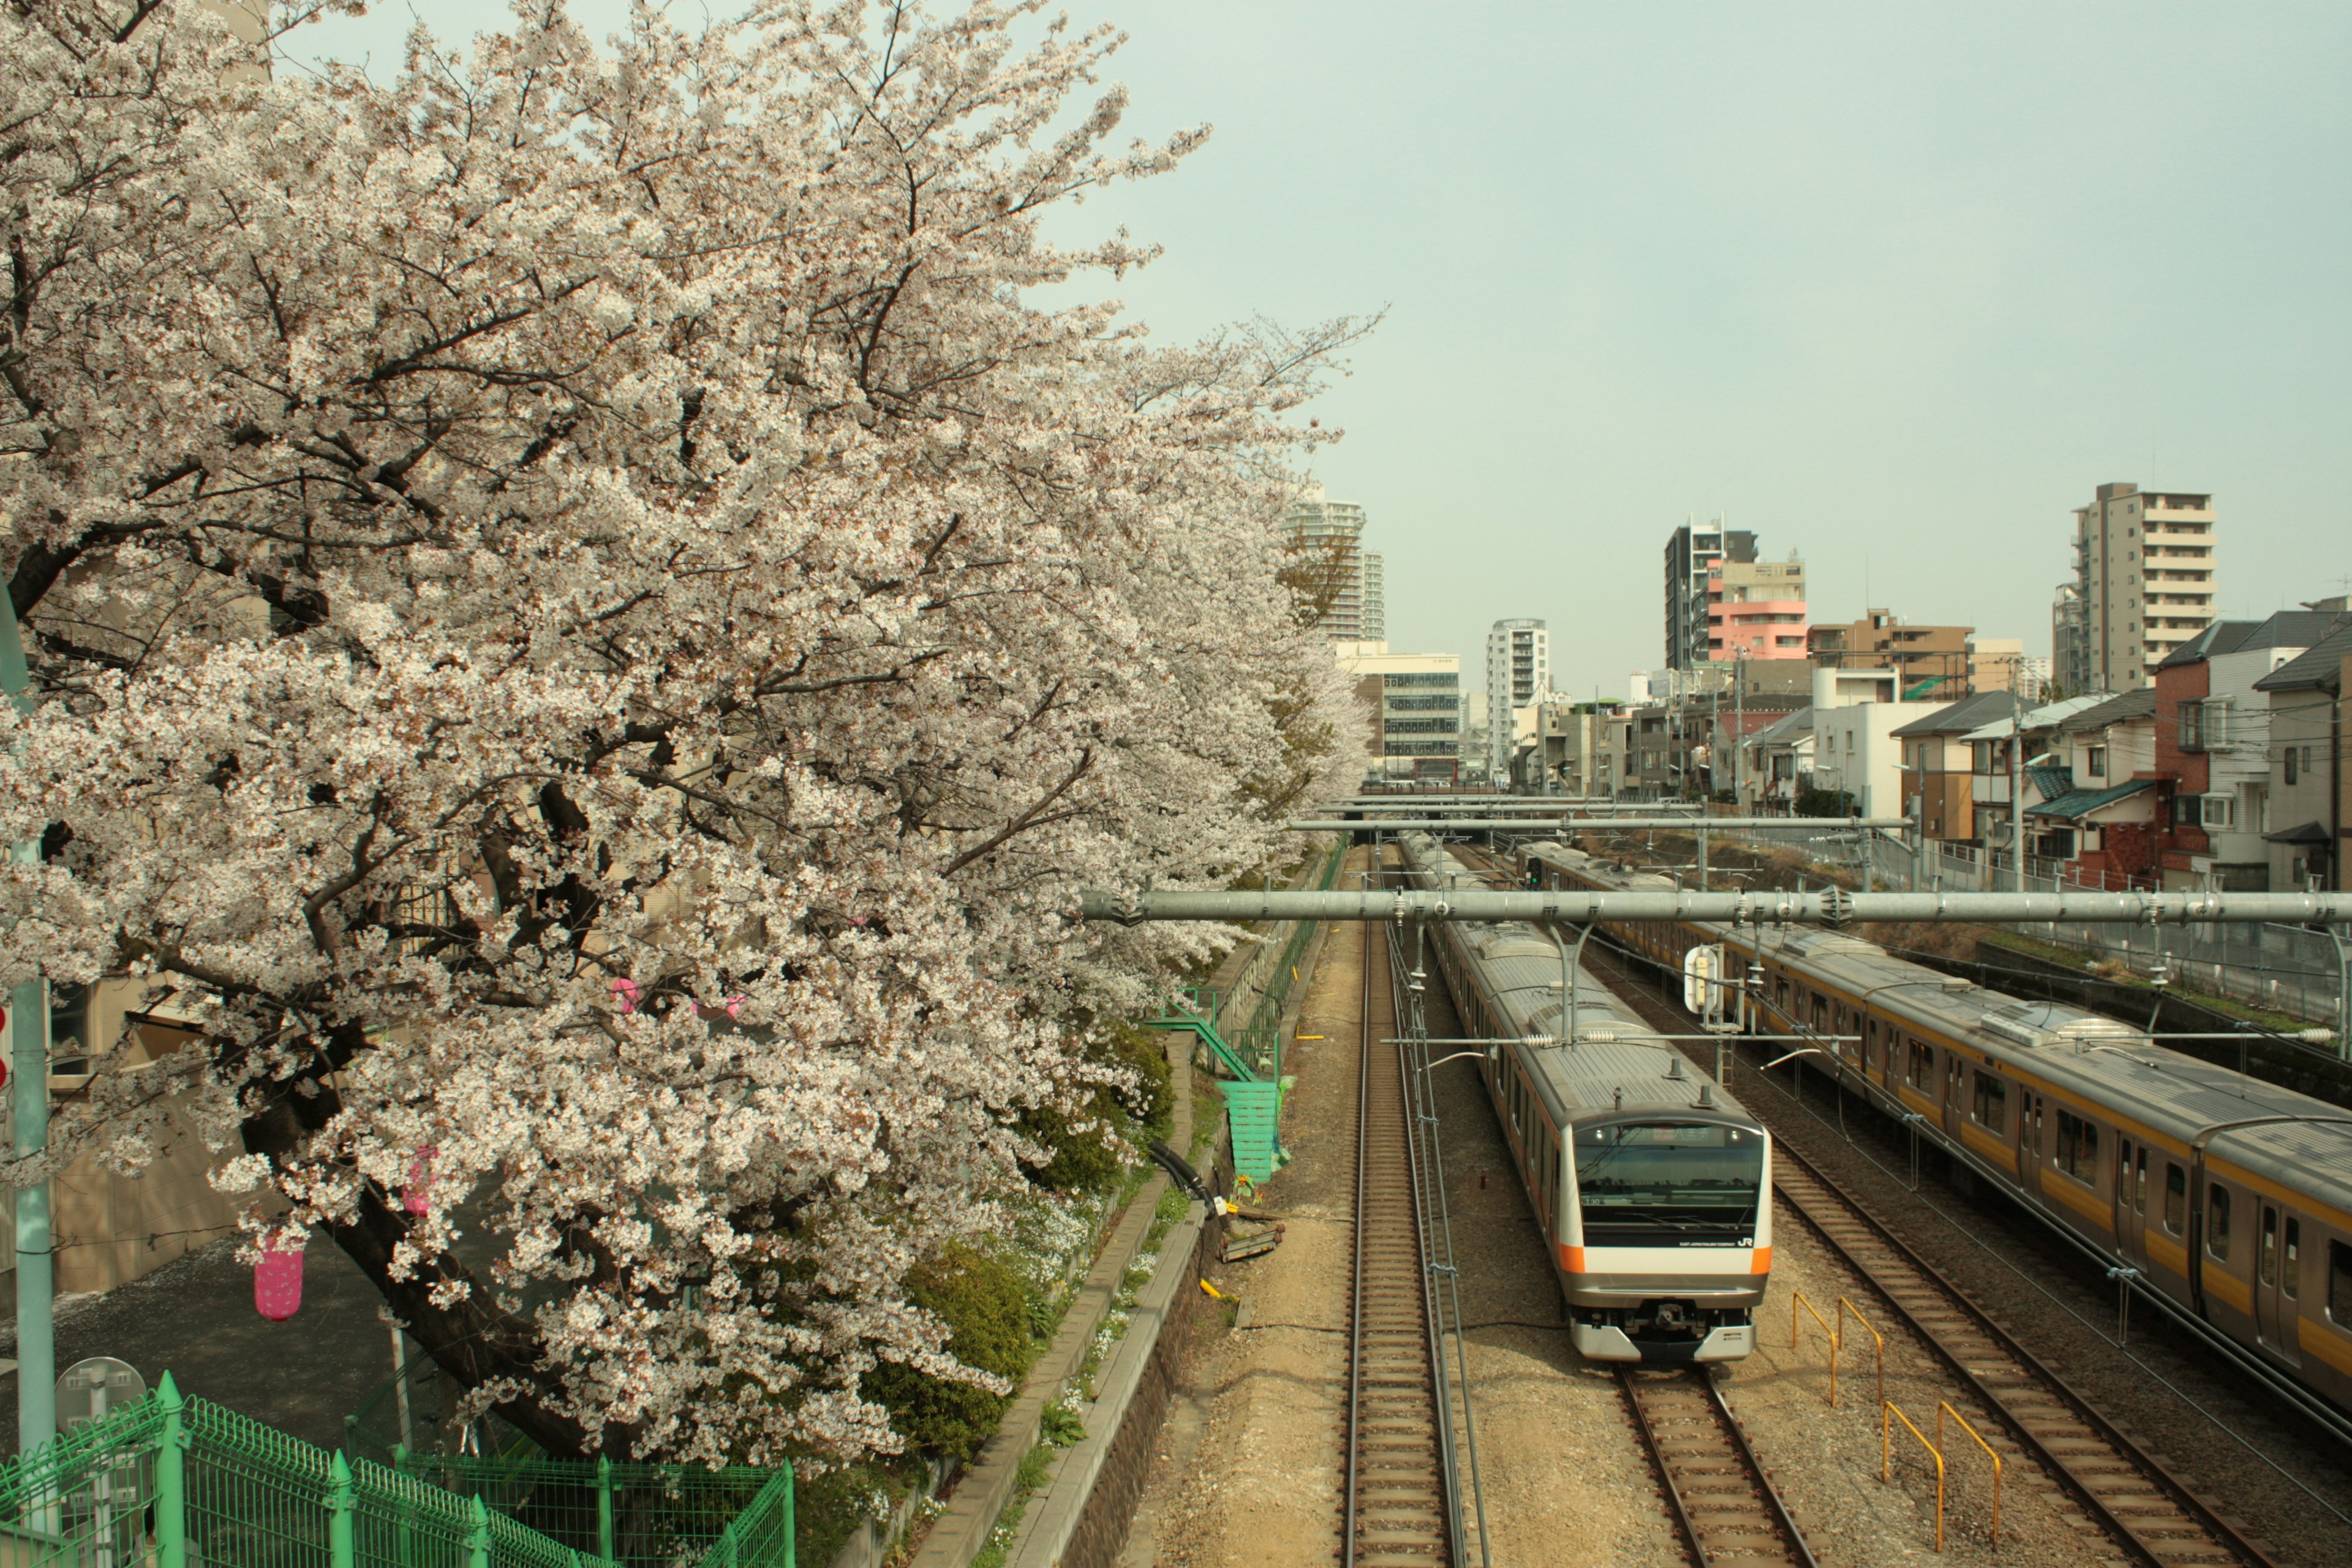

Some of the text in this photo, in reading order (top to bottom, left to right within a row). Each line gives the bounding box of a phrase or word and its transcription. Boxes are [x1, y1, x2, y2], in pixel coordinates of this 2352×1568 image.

[1675, 1128, 1709, 1138] 八王子
[1738, 1237, 1753, 1246] JR
